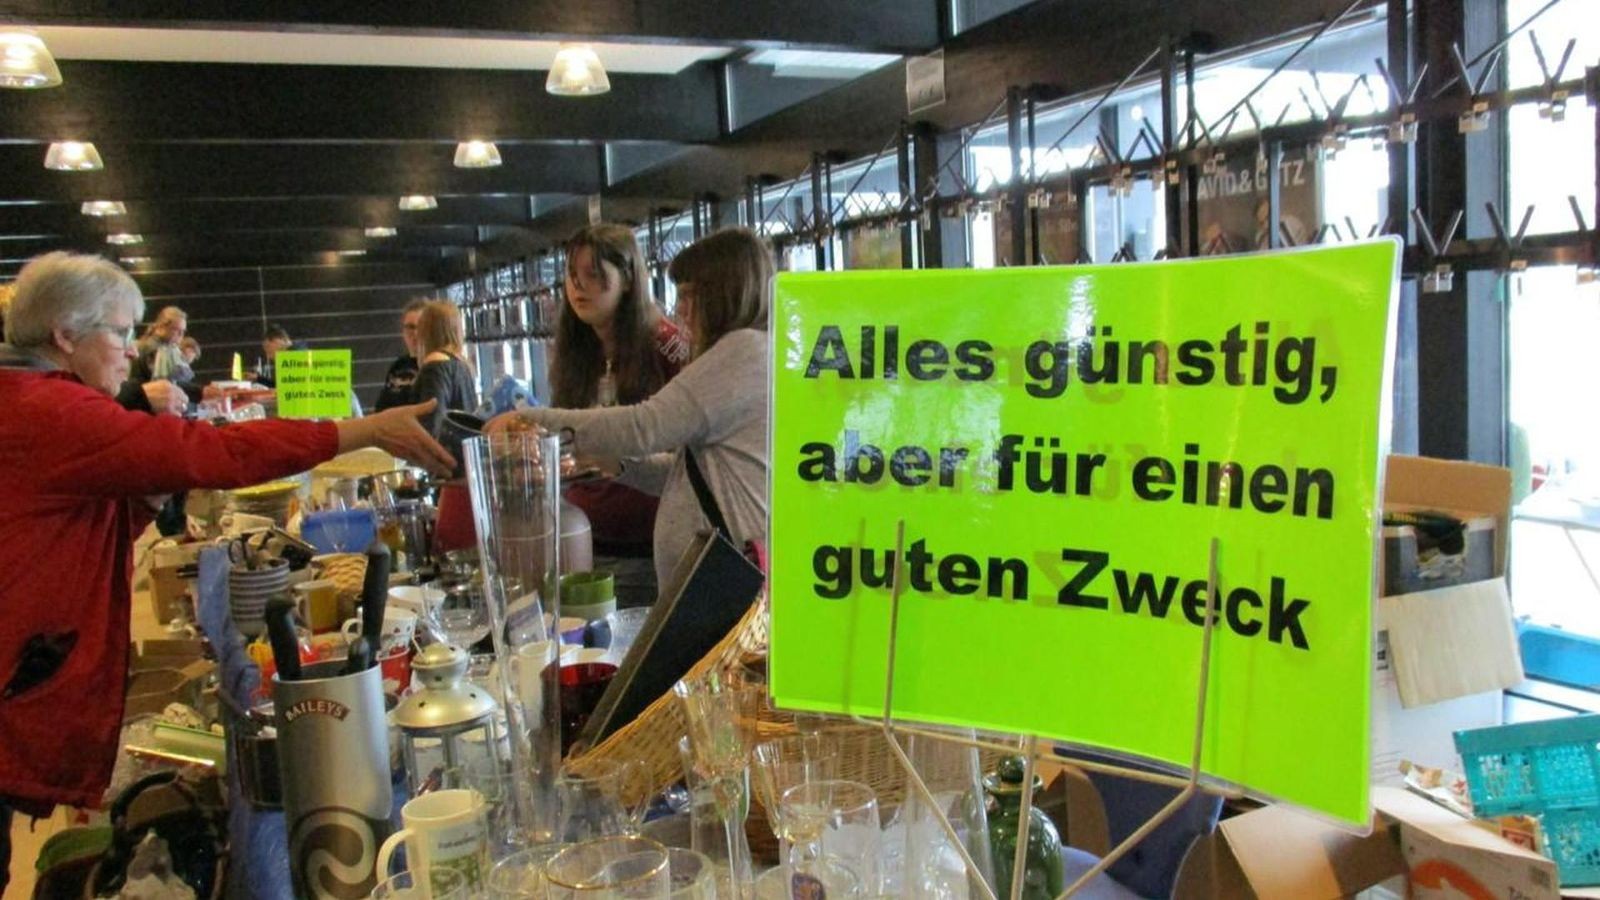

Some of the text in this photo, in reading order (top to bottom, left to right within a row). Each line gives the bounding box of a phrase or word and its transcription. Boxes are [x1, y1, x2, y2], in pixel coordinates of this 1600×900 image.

[803, 321, 1338, 405] Alles günstig,
[797, 429, 1335, 520] aber für einen
[812, 537, 1311, 651] guten Zweck
